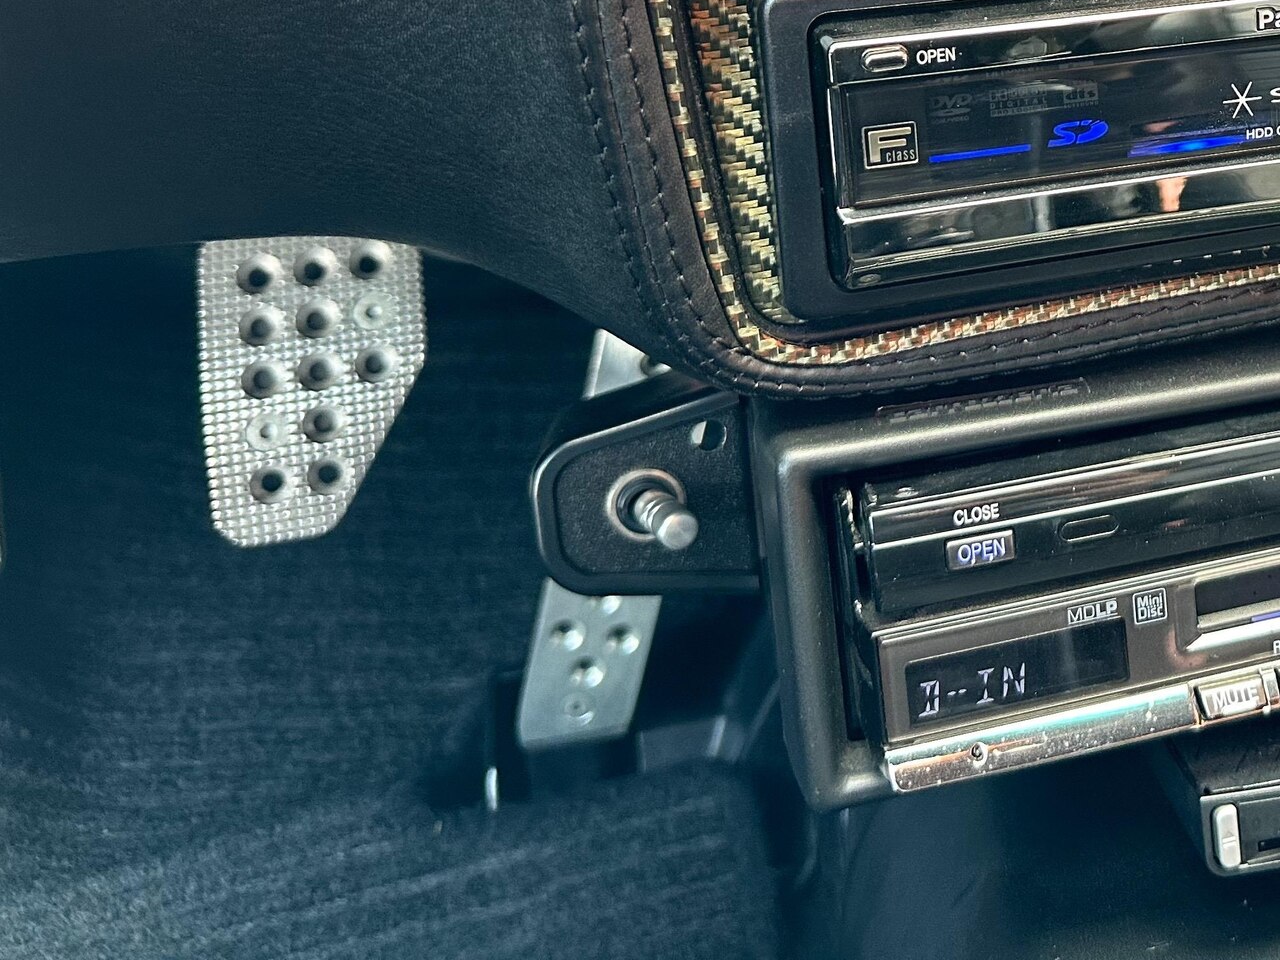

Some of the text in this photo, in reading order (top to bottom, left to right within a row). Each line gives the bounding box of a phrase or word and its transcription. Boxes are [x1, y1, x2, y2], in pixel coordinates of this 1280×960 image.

[916, 47, 956, 66] OPEN
[1048, 119, 1109, 148] SD
[1246, 125, 1273, 140] HDD
[867, 127, 912, 163] F
[885, 148, 915, 163] class
[953, 503, 1000, 526] CLOSE
[957, 537, 1006, 564] OPEN
[1136, 592, 1163, 608] Mini
[1067, 600, 1118, 624] MDLP
[1137, 606, 1164, 621] Disc
[1210, 685, 1260, 715] MUTE
